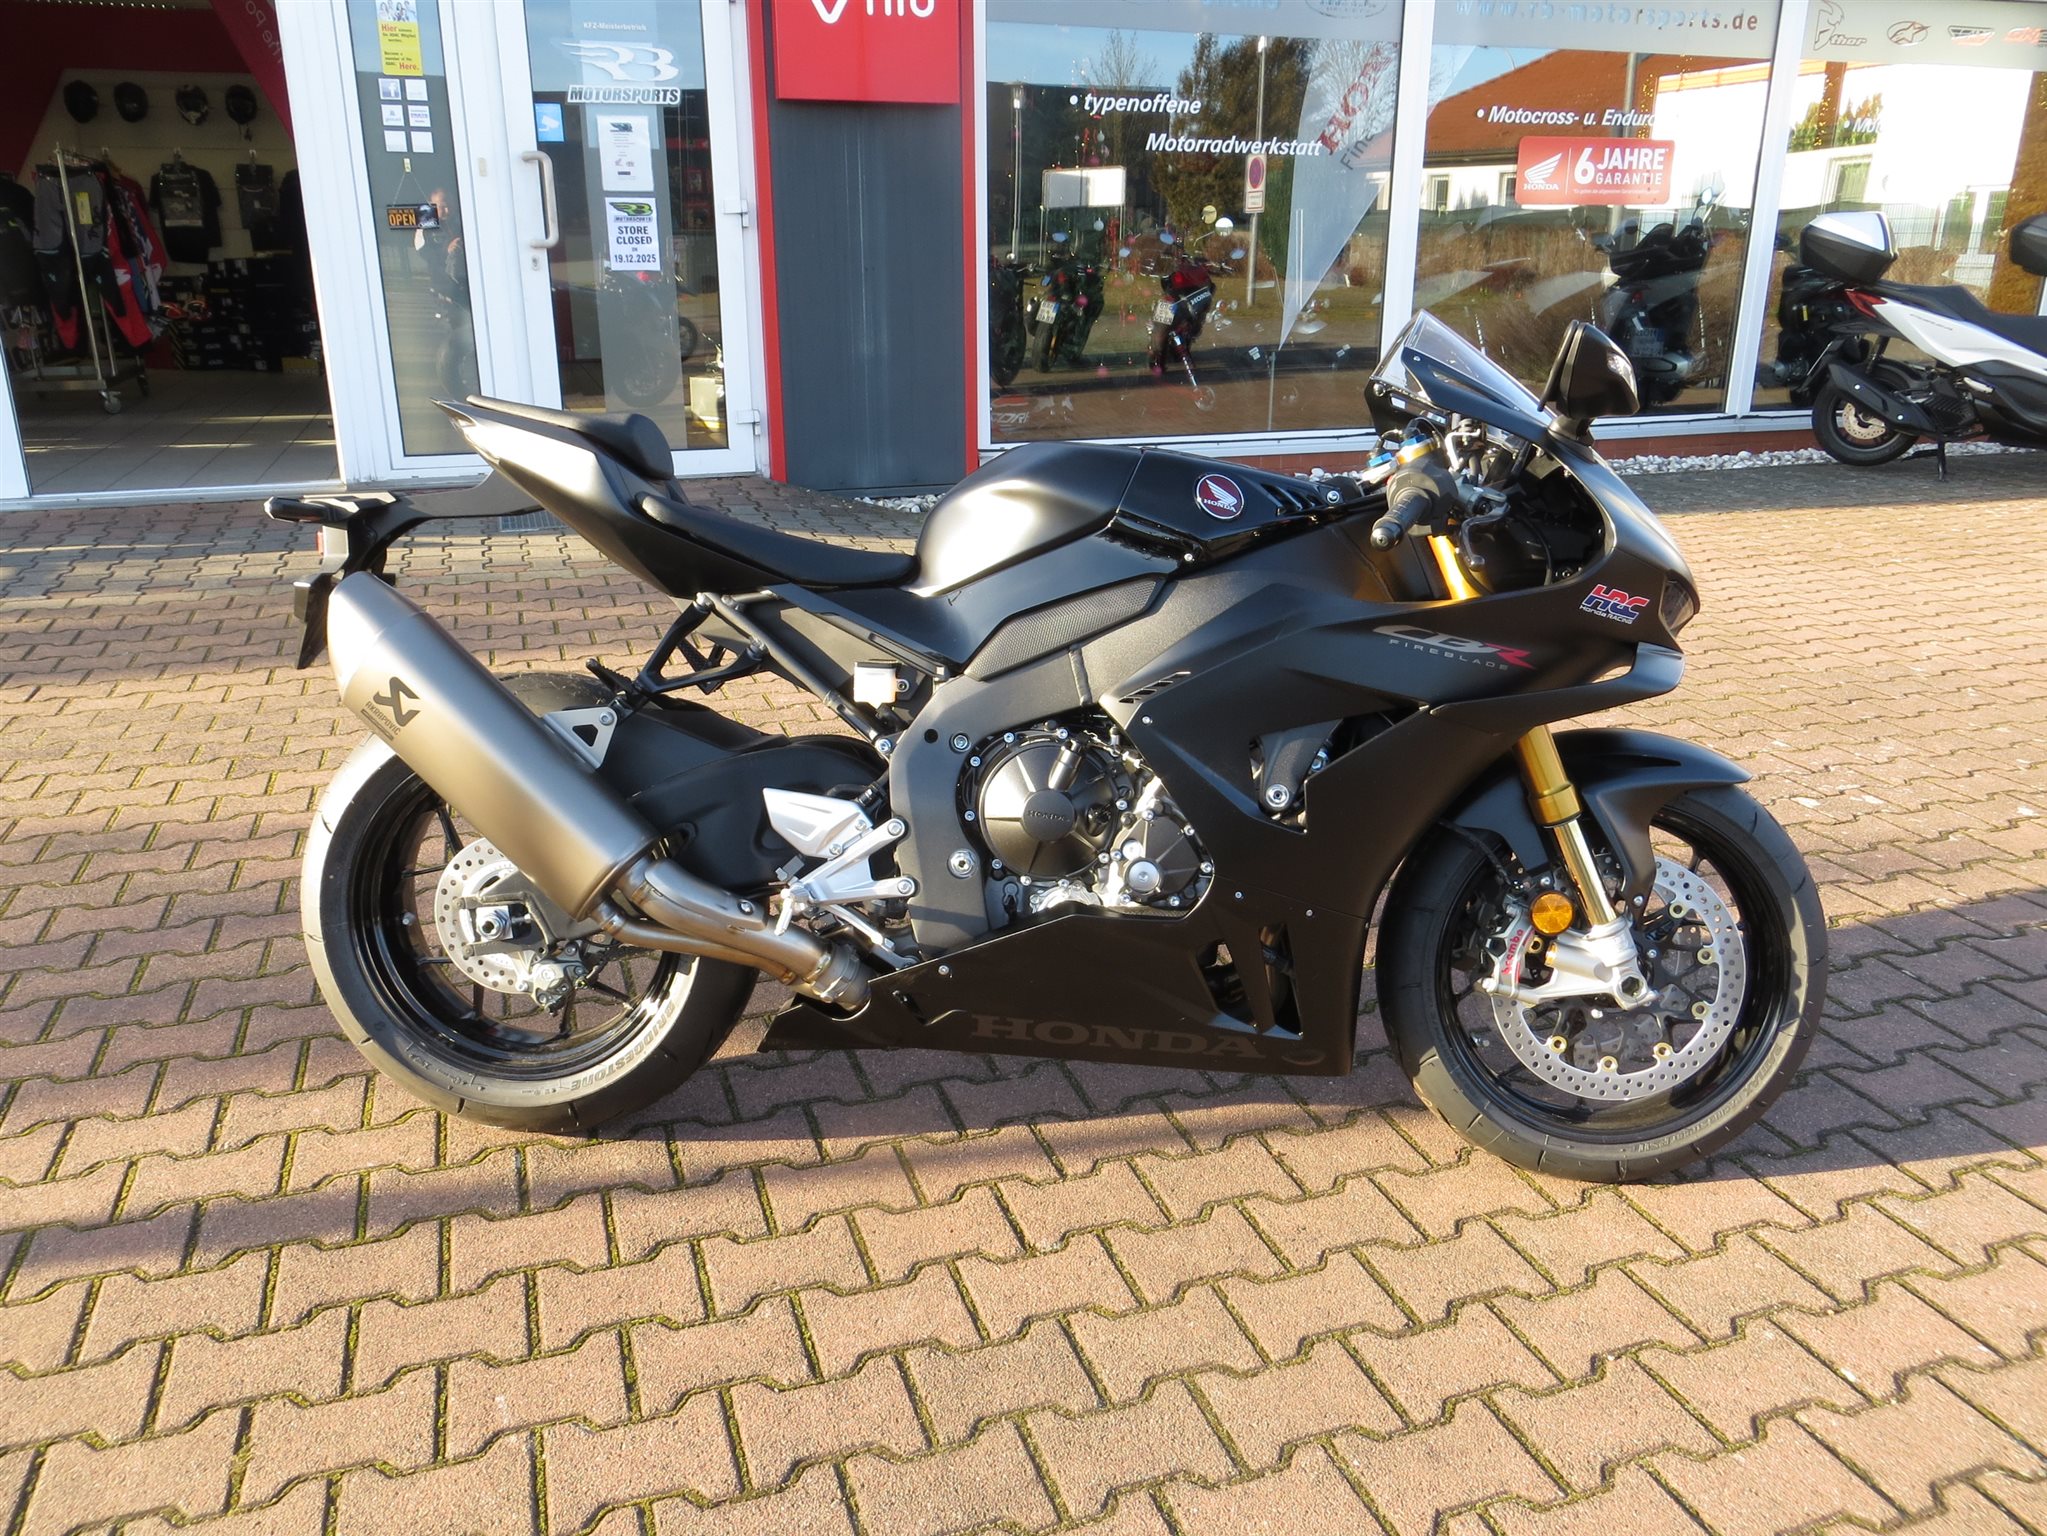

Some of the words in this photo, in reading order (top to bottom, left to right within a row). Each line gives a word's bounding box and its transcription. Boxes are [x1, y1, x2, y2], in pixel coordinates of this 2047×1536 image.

[381, 23, 397, 32] Hier
[399, 62, 420, 71] Here.
[569, 86, 680, 104] MOTORSPORTS
[1083, 93, 1201, 115] typenoffene
[1488, 105, 1580, 125] Motocross-
[1583, 110, 1597, 126] u.
[1145, 133, 1323, 157] Motorradwerkstatt
[1573, 147, 1596, 185] 6
[1523, 183, 1560, 191] HONDA
[1596, 172, 1663, 185] GARANTIE
[389, 214, 417, 226] OPEN
[617, 226, 649, 235] STORE
[616, 236, 653, 245] CLOSED
[614, 254, 657, 263] 19.12.2025
[1203, 498, 1237, 513] HONDA
[1581, 583, 1650, 620] HRC
[1579, 604, 1607, 618] Honda
[1606, 613, 1633, 625] RACING
[1389, 638, 1508, 671] FIREBLADE
[1501, 929, 1525, 975] brembo
[971, 1014, 1266, 1059] HONDA
[571, 1002, 676, 1091] BRIDGESTONE
